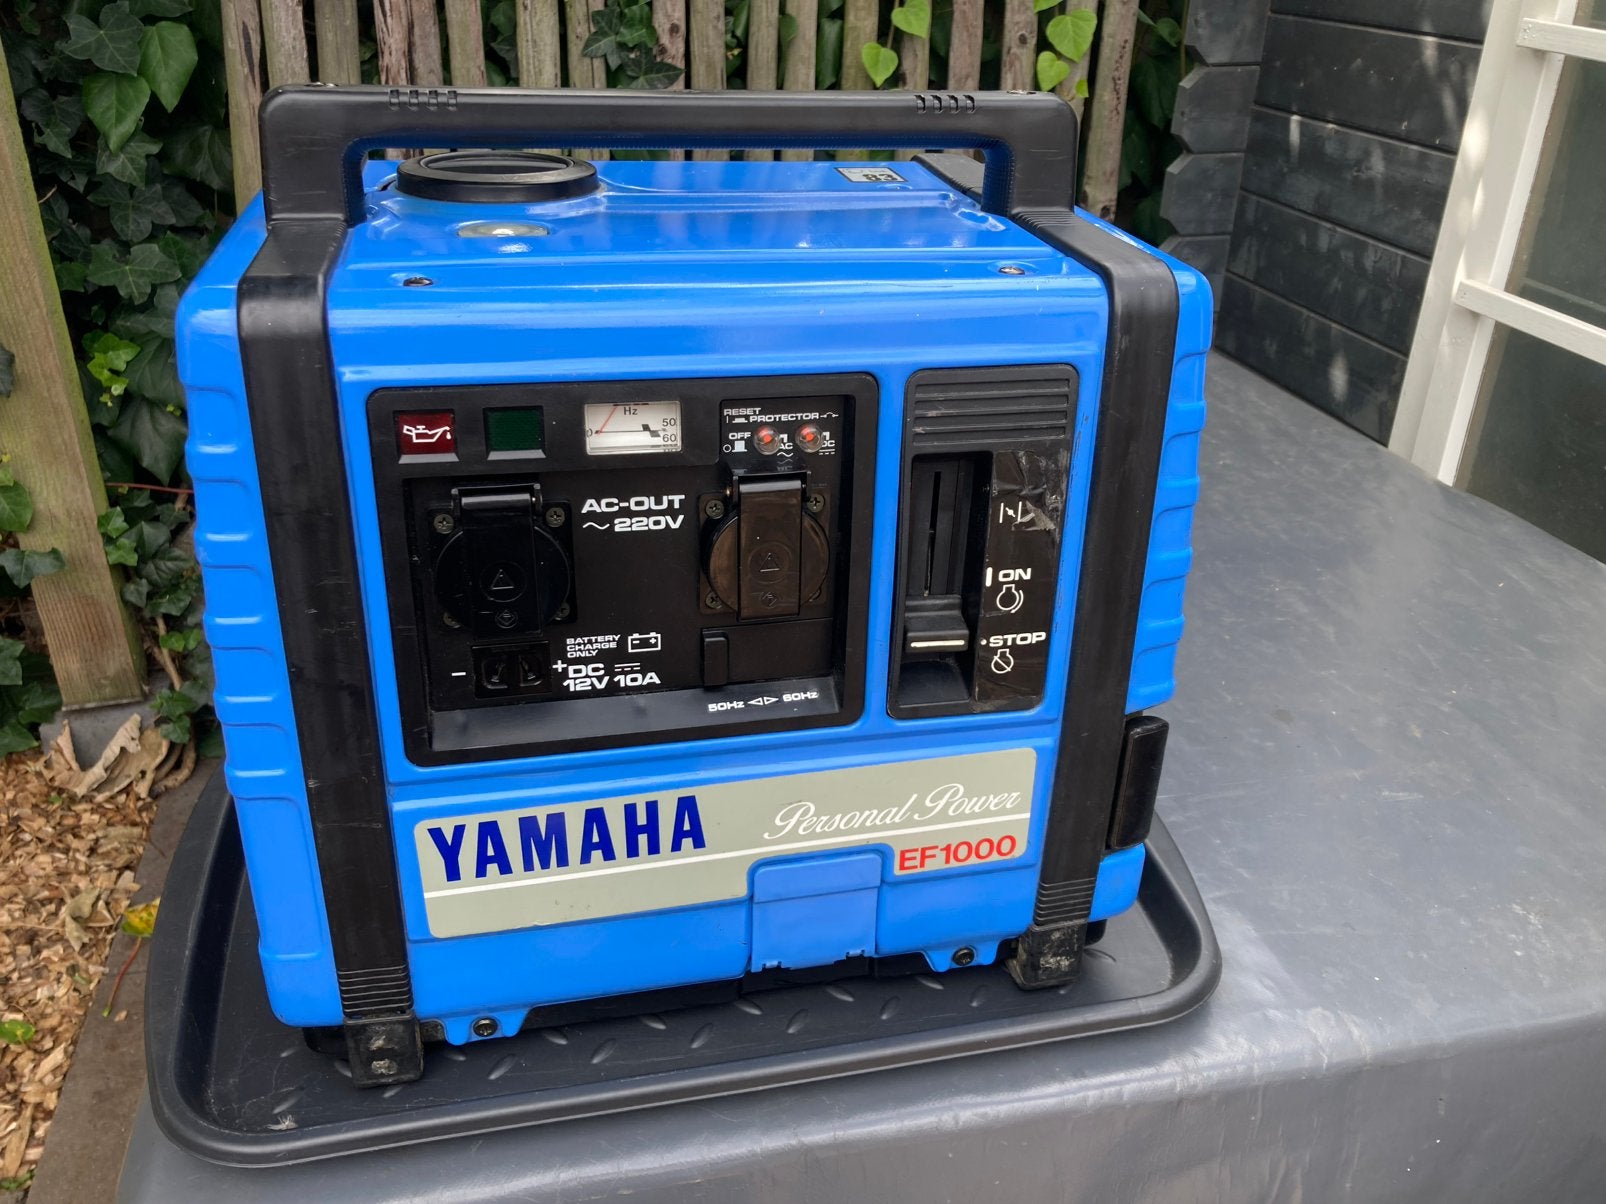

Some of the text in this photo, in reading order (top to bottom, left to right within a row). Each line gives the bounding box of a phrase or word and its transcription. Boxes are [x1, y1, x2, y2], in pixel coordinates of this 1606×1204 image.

[623, 406, 638, 416] Hz
[723, 407, 762, 416] RESET
[662, 417, 677, 427] 50
[749, 412, 820, 423] PROTECTOR
[662, 433, 677, 443] 60
[728, 431, 751, 440] OFF
[779, 442, 794, 450] AC
[581, 494, 686, 514] AC-OUT
[613, 514, 685, 532] 220V
[998, 567, 1032, 581] ON
[566, 634, 621, 645] BATTERY
[988, 631, 1047, 648] STOP
[566, 641, 618, 651] CHARGE
[567, 649, 599, 658] ONLY
[562, 671, 662, 692] 12V 10A
[762, 783, 1022, 840] Personal Power
[427, 794, 707, 883] YAMAHA
[898, 834, 1017, 871] EF1000
